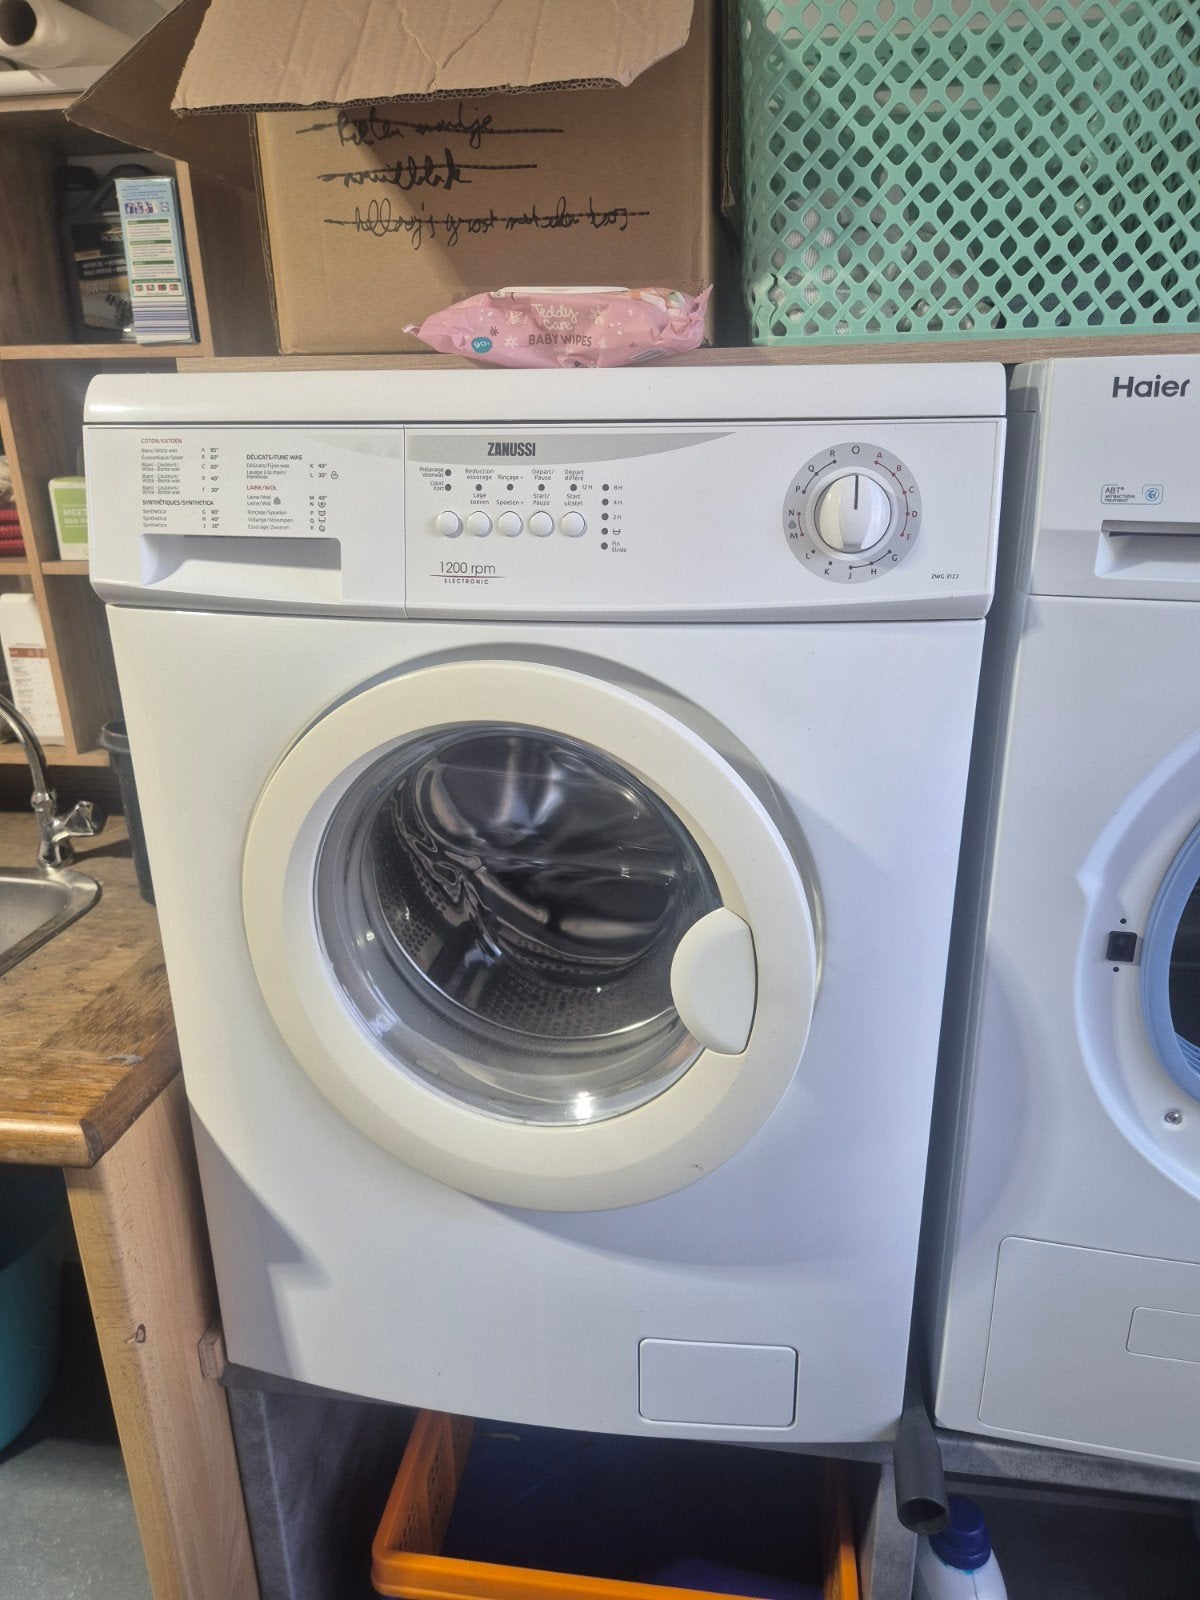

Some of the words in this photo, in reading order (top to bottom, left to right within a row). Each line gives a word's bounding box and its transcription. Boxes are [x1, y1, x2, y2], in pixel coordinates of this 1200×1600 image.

[532, 303, 579, 324] Teddy
[544, 317, 573, 331] Care
[528, 333, 558, 346] BABY
[560, 334, 592, 347] WIPES
[1112, 374, 1190, 398] Haier
[487, 442, 536, 457] ZANUSSI
[808, 465, 815, 473] Q
[440, 561, 467, 573] 1200
[471, 565, 496, 576] rpm
